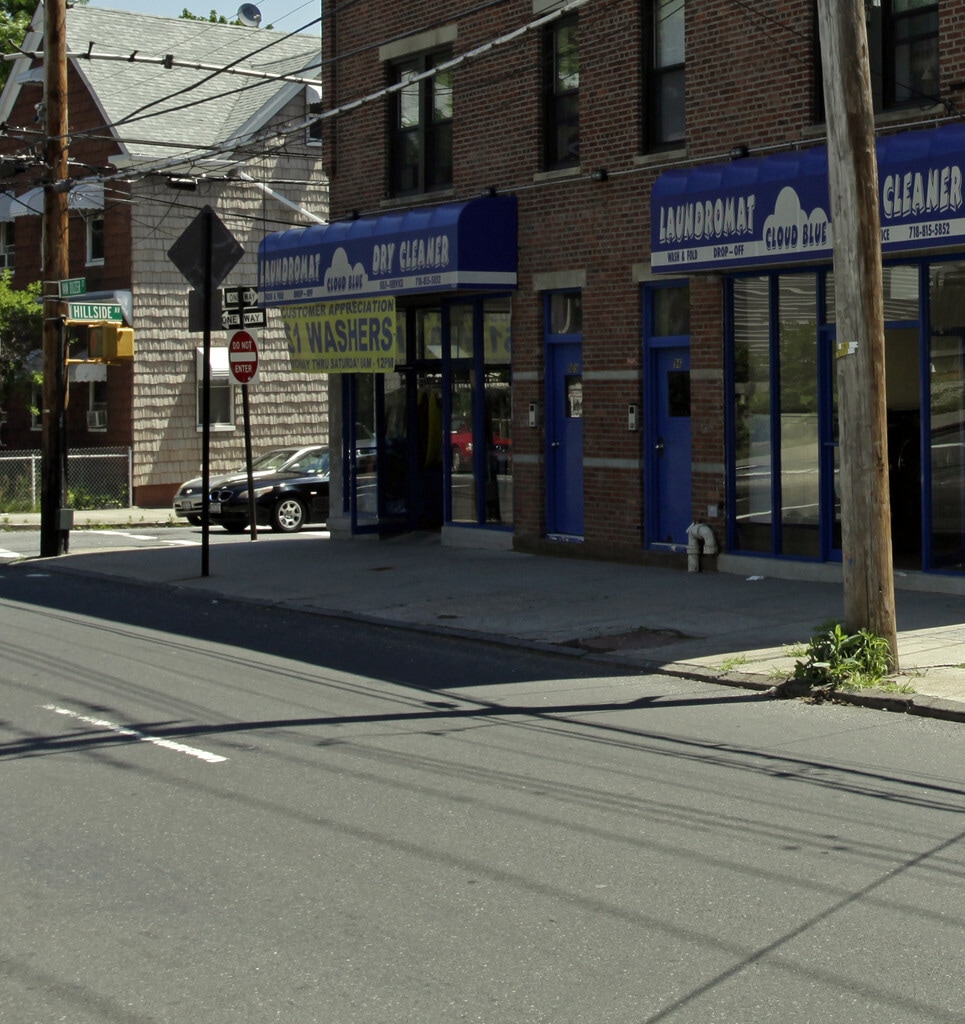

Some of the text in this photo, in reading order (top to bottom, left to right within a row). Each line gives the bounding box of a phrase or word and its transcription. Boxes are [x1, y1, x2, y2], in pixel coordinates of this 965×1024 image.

[882, 165, 963, 219] CLEANER
[659, 194, 756, 244] LAUNDROMAT
[765, 222, 827, 251] CLOUD BLUE
[908, 222, 951, 239] 718-815-5852
[372, 234, 450, 275] DRY CLEANER
[667, 251, 680, 263] WASH
[686, 249, 698, 261] FOLD
[260, 253, 321, 287] LAUNDROMAT
[327, 274, 363, 292] CLOUD BLUE
[243, 291, 255, 301] WAY
[73, 305, 113, 319] HILLSIDE
[281, 299, 394, 318] CUSTOMER APPRECIATION
[221, 313, 260, 325] ONE WAY
[306, 316, 393, 354] WASHERS
[232, 341, 252, 350] DO NOT
[235, 364, 252, 373] ENTER
